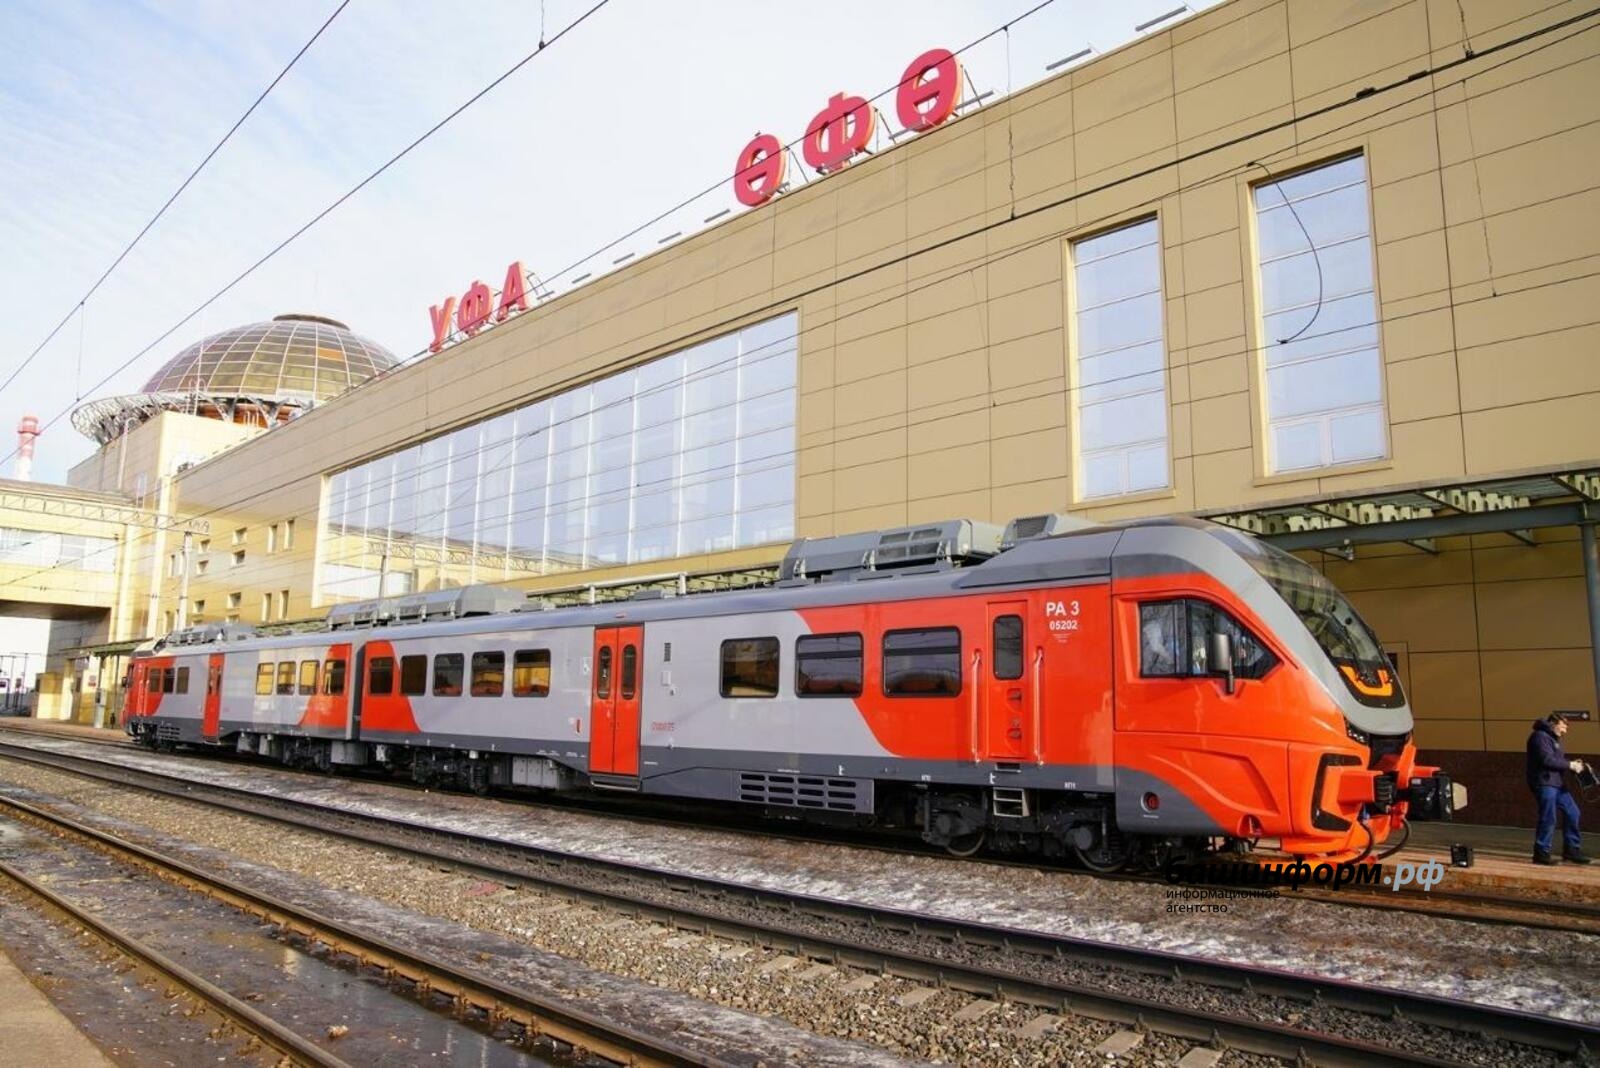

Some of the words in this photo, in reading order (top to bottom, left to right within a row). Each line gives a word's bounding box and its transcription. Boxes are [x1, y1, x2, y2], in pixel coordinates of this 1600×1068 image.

[428, 261, 527, 353] УФА
[1046, 600, 1067, 617] РА
[1070, 600, 1080, 616] 3
[1049, 619, 1078, 631] 05202
